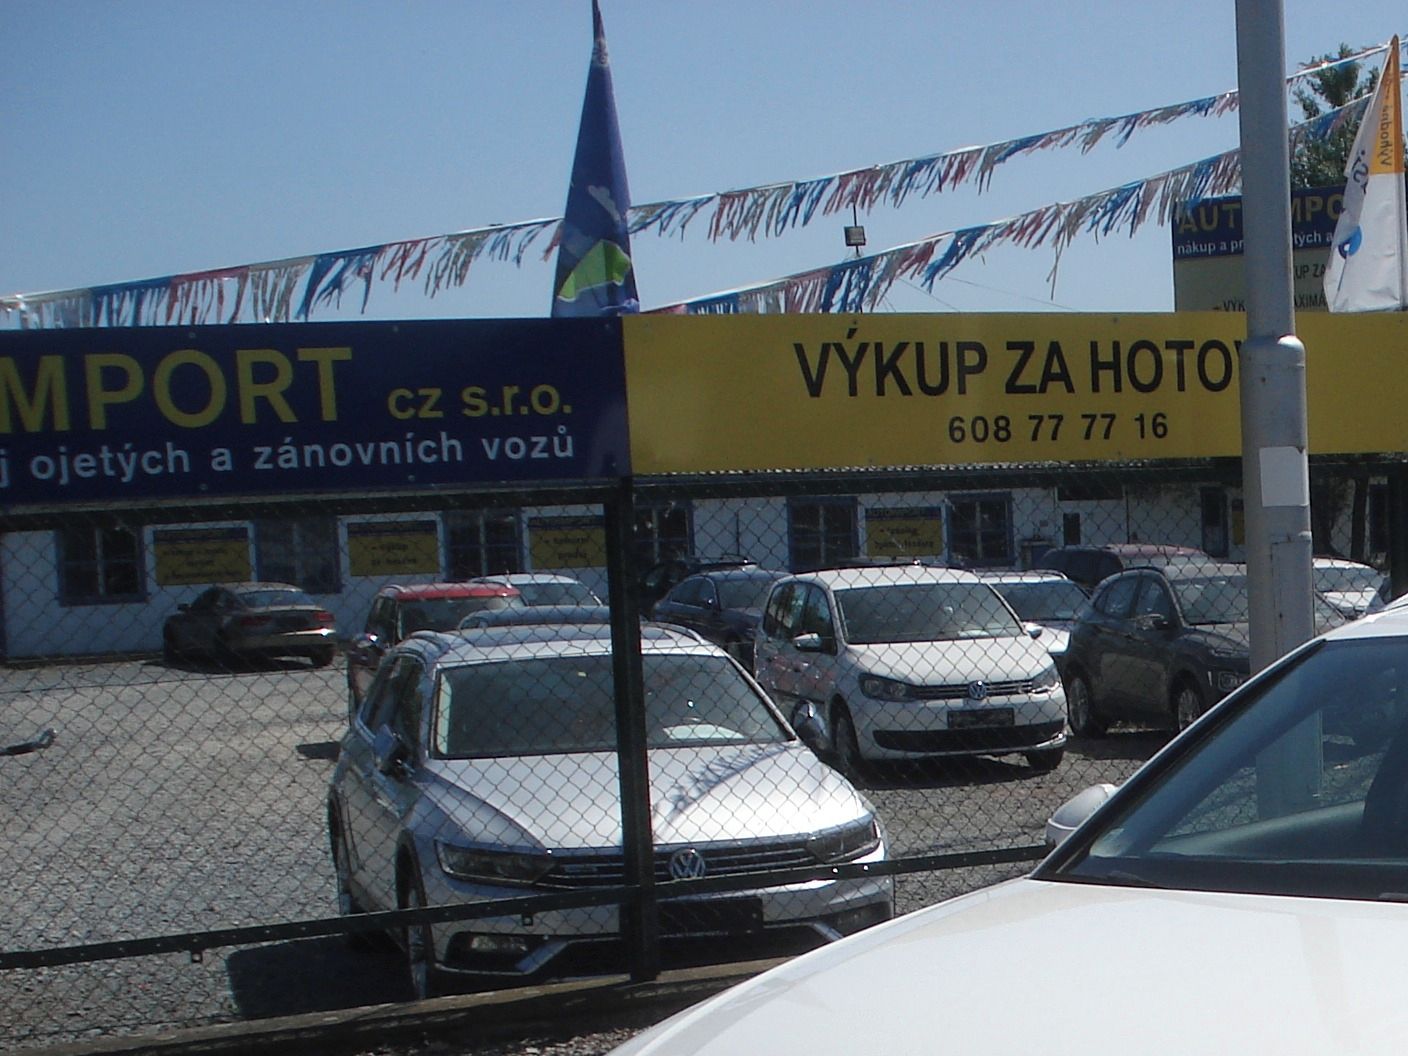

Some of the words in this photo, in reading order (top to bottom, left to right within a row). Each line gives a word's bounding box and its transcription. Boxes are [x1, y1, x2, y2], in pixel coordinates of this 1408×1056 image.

[1177, 240, 1216, 256] nákup
[1220, 241, 1228, 252] a
[793, 327, 988, 398] VÝKUP
[1005, 340, 1075, 394] ZA
[1089, 339, 1243, 393] HOTO
[387, 386, 444, 420] cz
[461, 384, 573, 417] s.r.o.
[948, 415, 1011, 443] 608
[1028, 413, 1064, 442] 77
[1081, 412, 1117, 440] 77
[1134, 411, 1169, 440] 16
[30, 442, 190, 486] ojetých
[210, 447, 233, 473] a
[254, 431, 463, 471] zánovních
[481, 424, 574, 460] vozů
